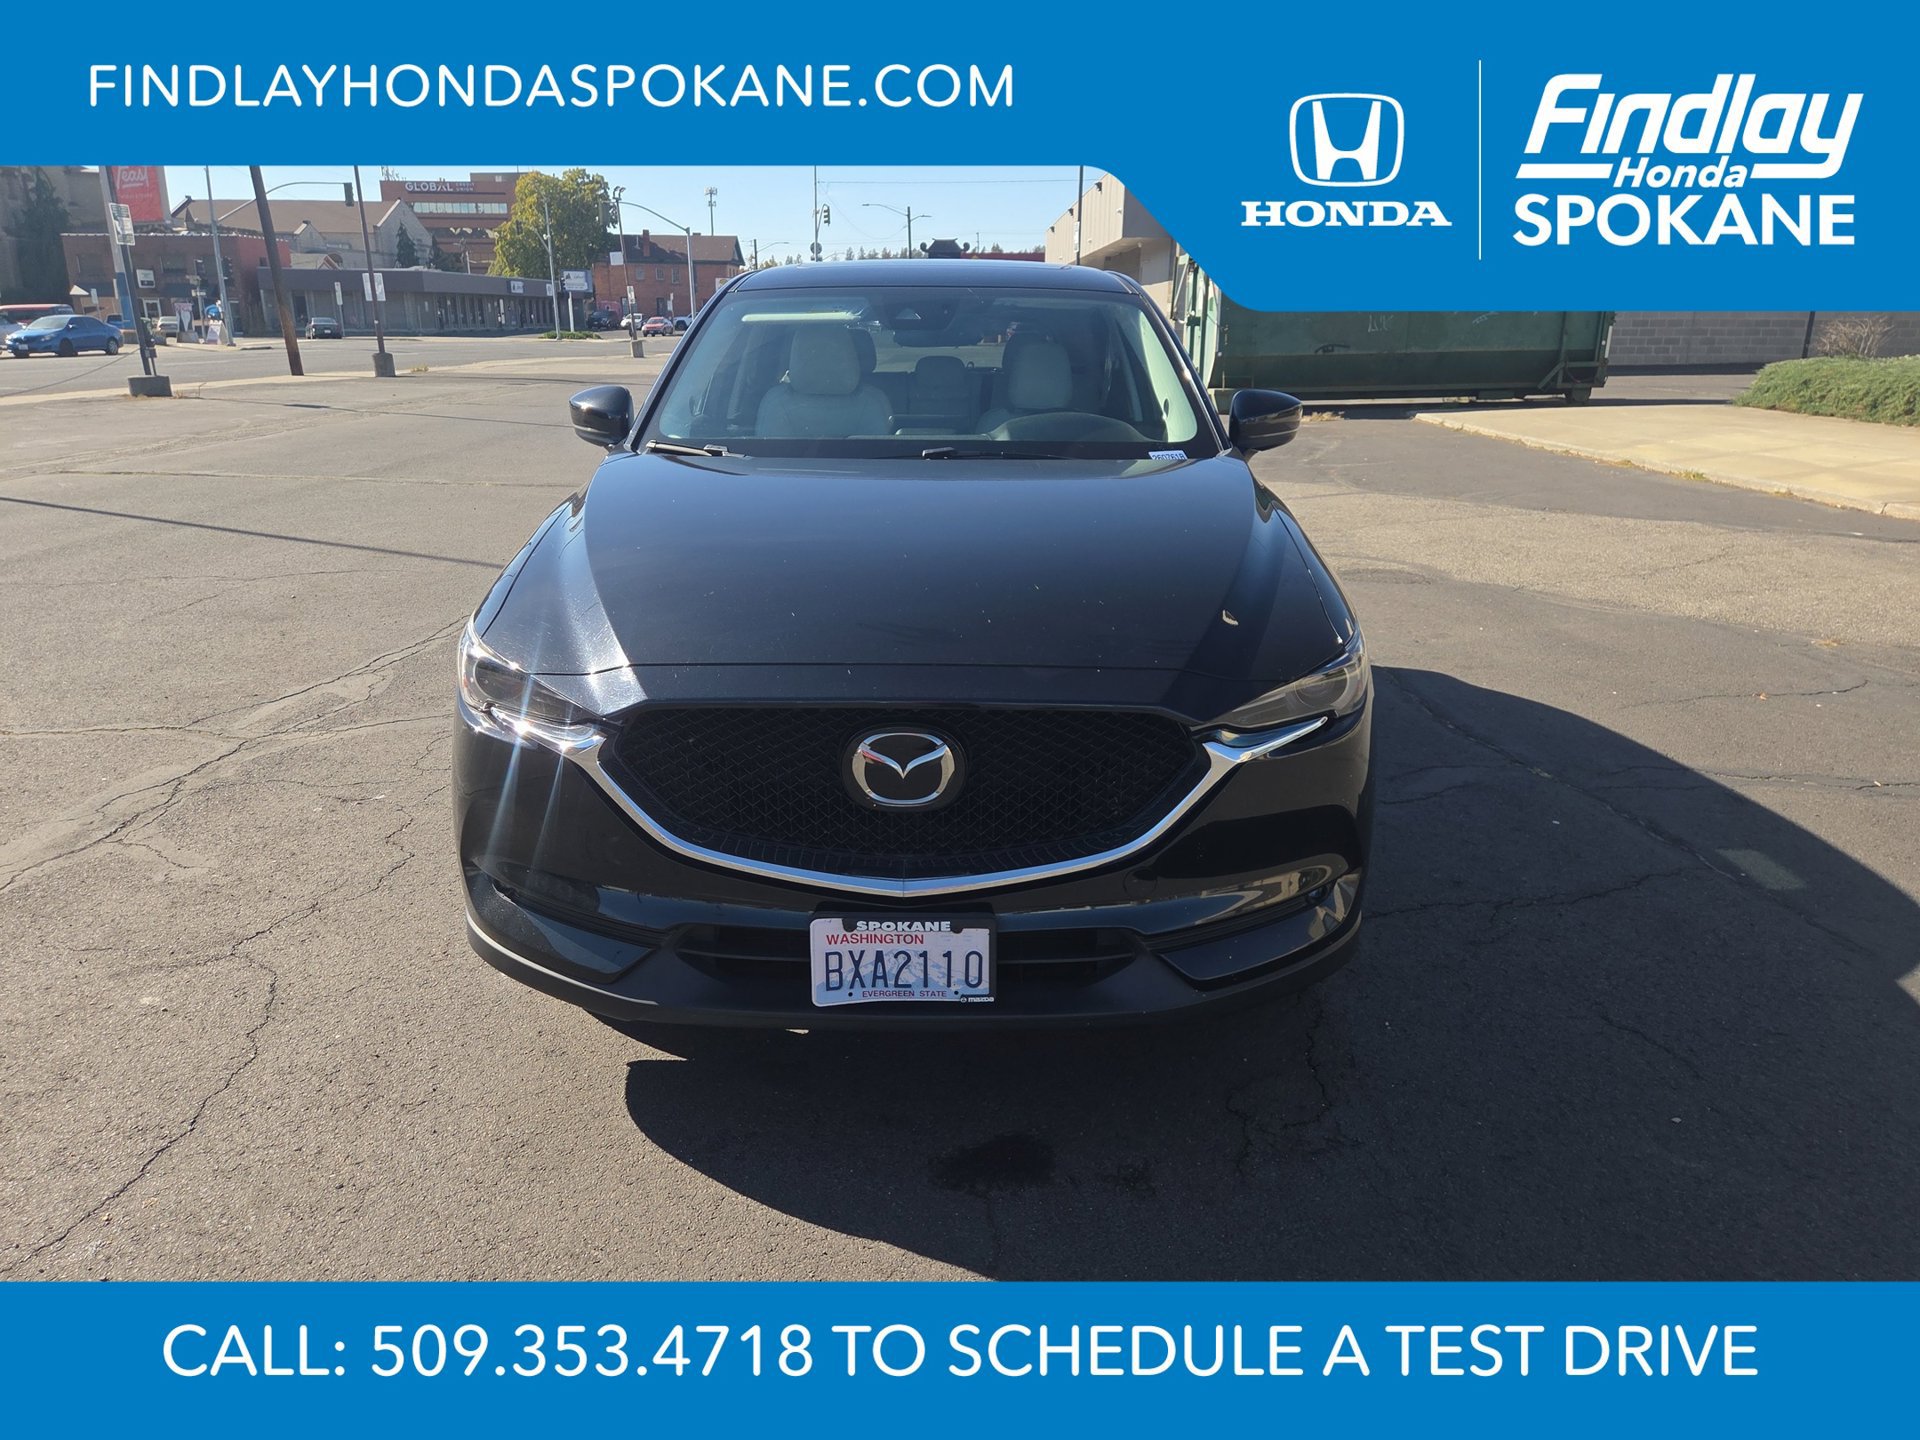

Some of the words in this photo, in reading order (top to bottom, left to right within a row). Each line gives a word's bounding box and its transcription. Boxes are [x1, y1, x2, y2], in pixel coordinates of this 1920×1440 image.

[405, 182, 453, 191] GLOBAL
[856, 920, 951, 932] SPOKANE
[826, 934, 924, 945] WASHINGTON
[825, 950, 983, 991] BXA2110
[862, 990, 915, 998] EVERGREEN
[919, 990, 947, 998] STATE
